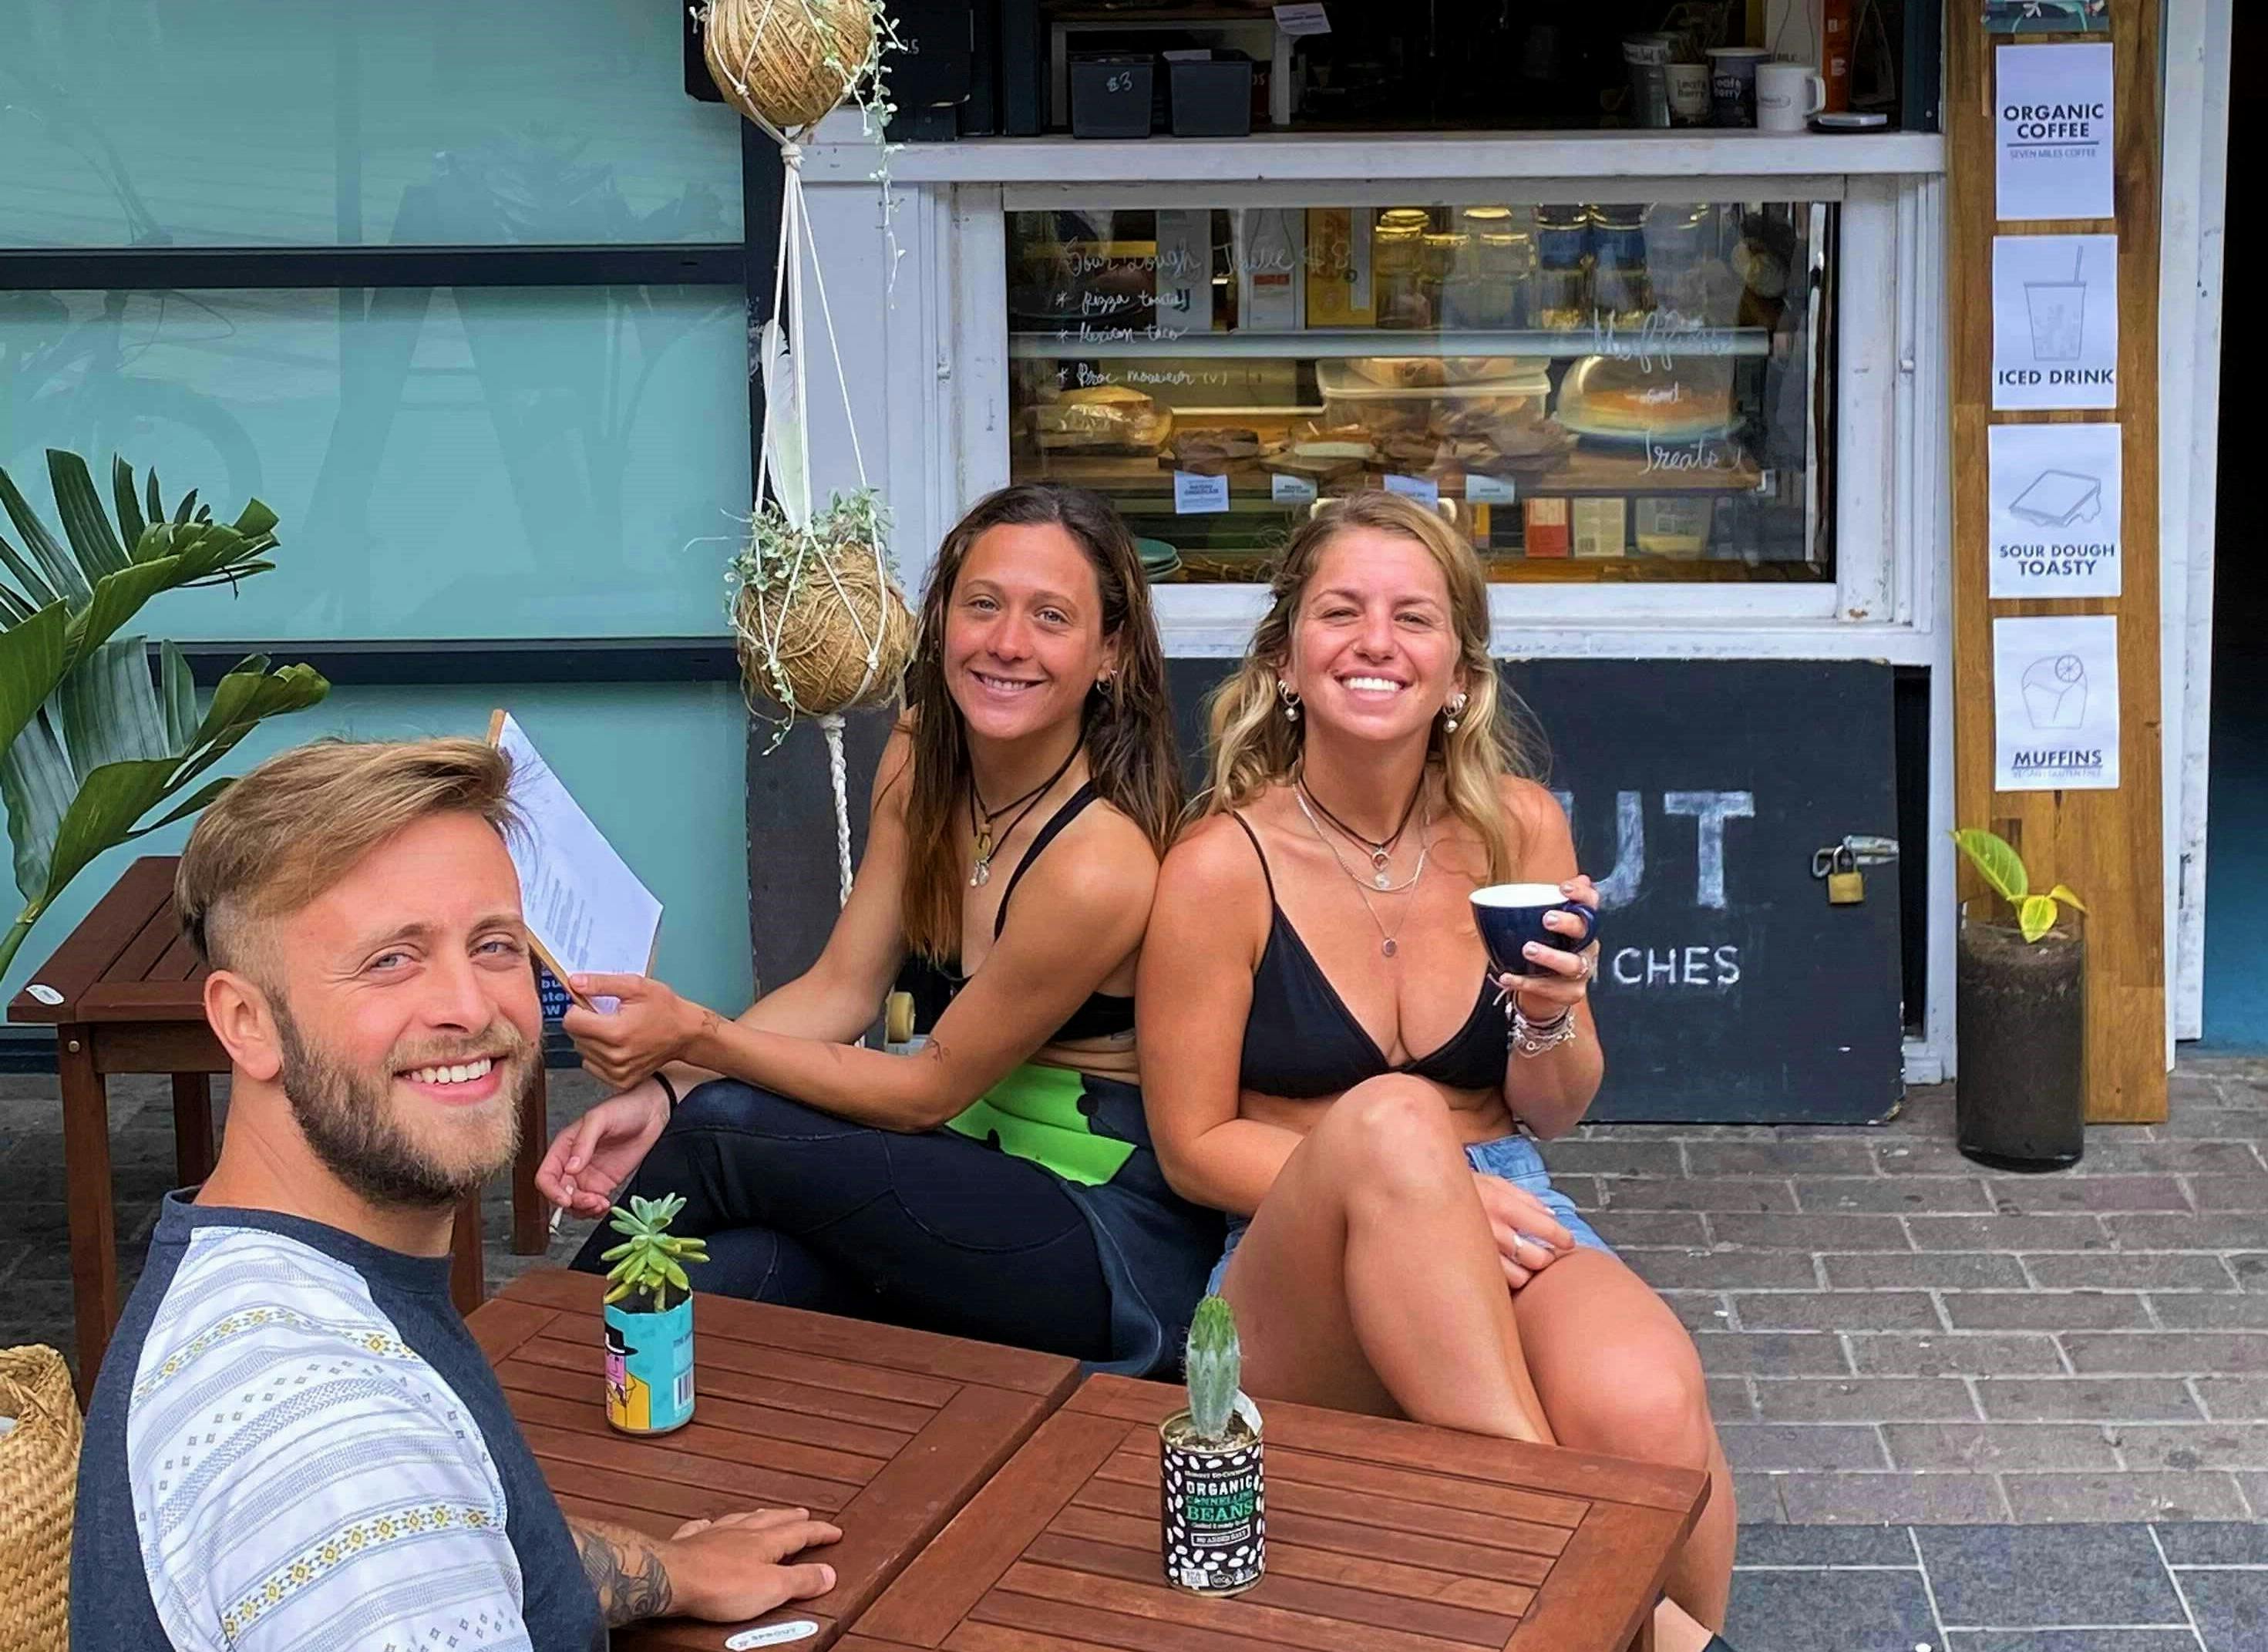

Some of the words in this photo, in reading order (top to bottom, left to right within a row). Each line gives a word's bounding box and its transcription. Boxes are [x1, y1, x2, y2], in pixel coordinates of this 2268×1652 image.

[2004, 103, 2105, 121] ORGANIC
[2017, 123, 2090, 139] COFFEE
[1998, 369, 2042, 385] ICED
[2049, 368, 2114, 385] DRINK
[1999, 544, 2045, 558] SOUR
[2051, 543, 2115, 557] DOUGH
[2017, 560, 2098, 577] TOASTY
[2013, 749, 2102, 766] MUFFINS
[1186, 1474, 1253, 1496] ORGANIC
[1186, 1499, 1254, 1522] BEANS
